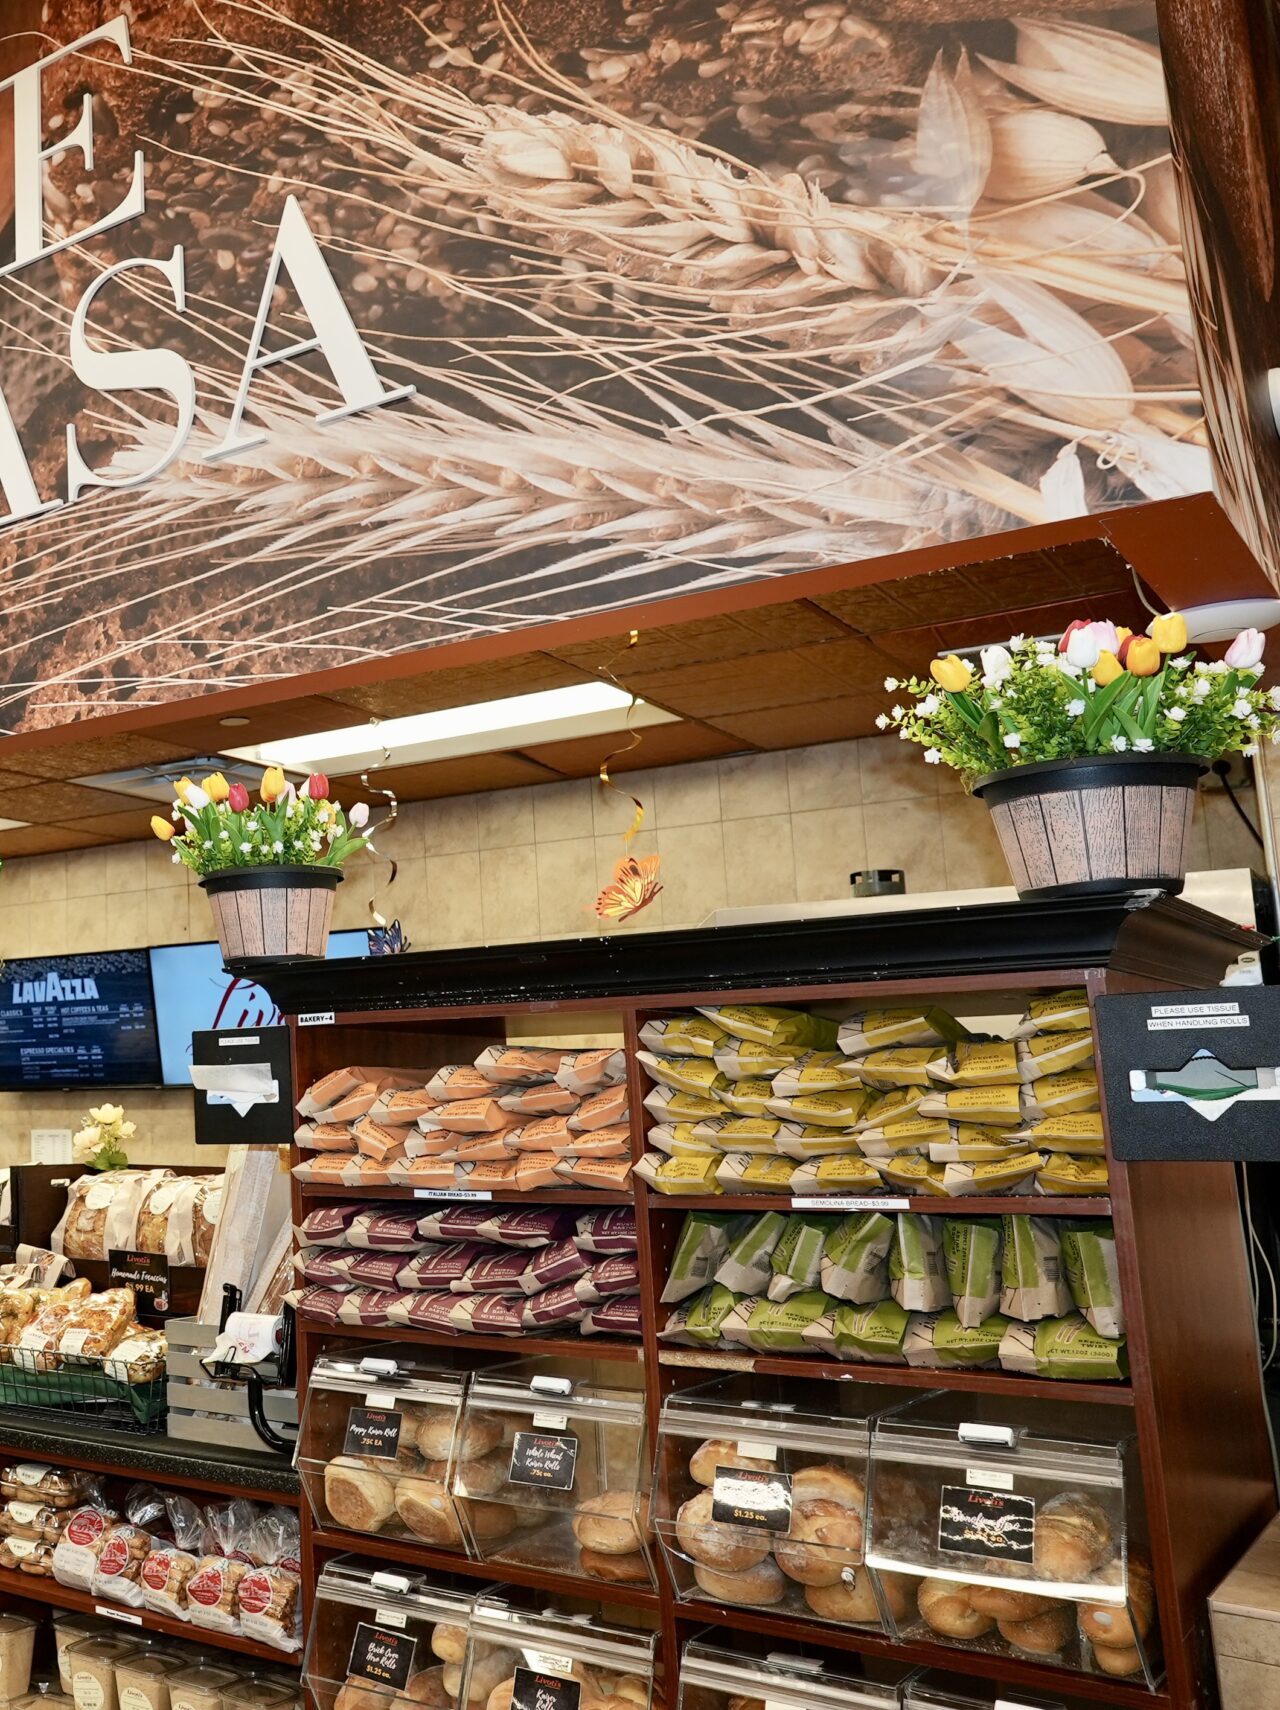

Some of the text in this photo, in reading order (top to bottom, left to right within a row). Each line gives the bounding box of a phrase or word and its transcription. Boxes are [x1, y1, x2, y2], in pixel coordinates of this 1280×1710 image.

[12, 972, 99, 1004] LAVAZZA
[1153, 1007, 1185, 1015] PLEASE
[300, 1015, 333, 1023] BAKERY-4
[1149, 1020, 1174, 1028] WHEN
[145, 1285, 154, 1293] EA
[350, 1424, 367, 1436] Poppy
[526, 1446, 543, 1458] Whole
[733, 1508, 754, 1519] $1.25
[368, 1642, 385, 1655] Brick
[366, 1664, 382, 1676] $1.25
[536, 1688, 558, 1703] Kaiser
